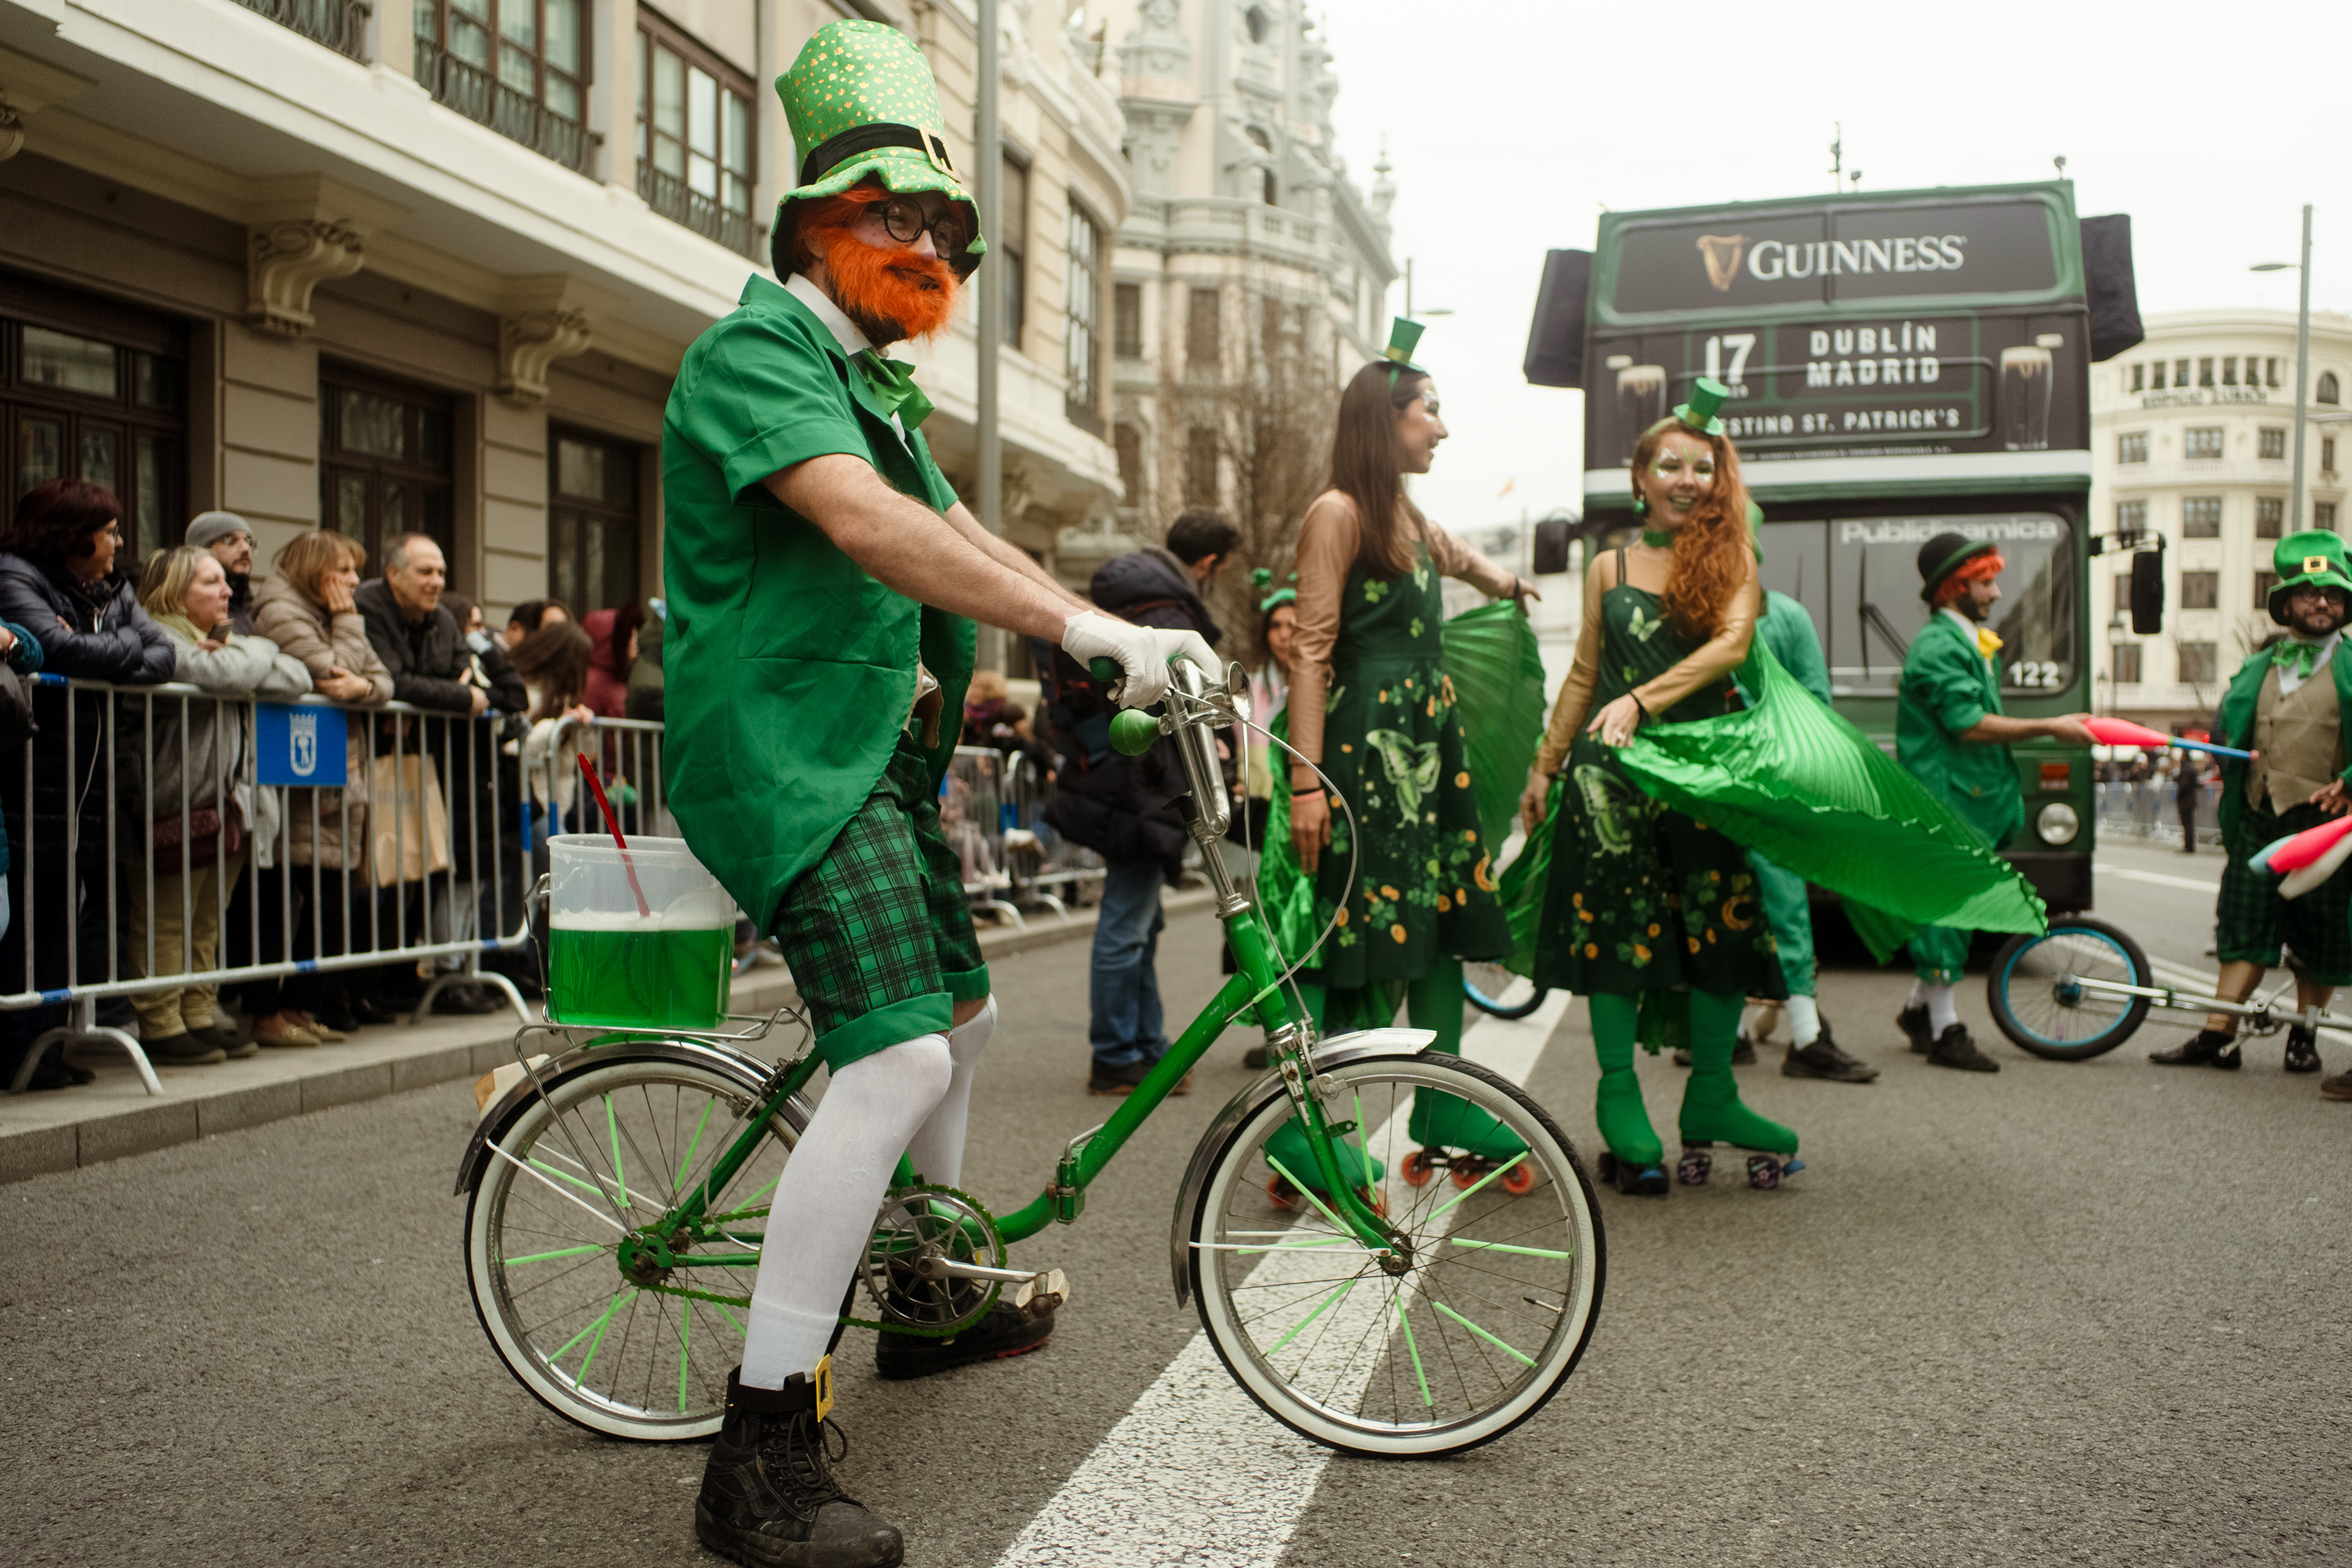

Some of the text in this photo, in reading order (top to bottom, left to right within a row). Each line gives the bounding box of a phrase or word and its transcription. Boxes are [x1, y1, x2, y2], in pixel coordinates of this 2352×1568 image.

[1747, 235, 1965, 281] GUINNESS
[1810, 321, 1936, 356] DUBLÍN
[1705, 333, 1757, 385] 17
[1806, 356, 1940, 387] MADRID
[1717, 408, 1960, 436] ESTINO ST. PATRICK'S
[2010, 661, 2059, 685] 122
